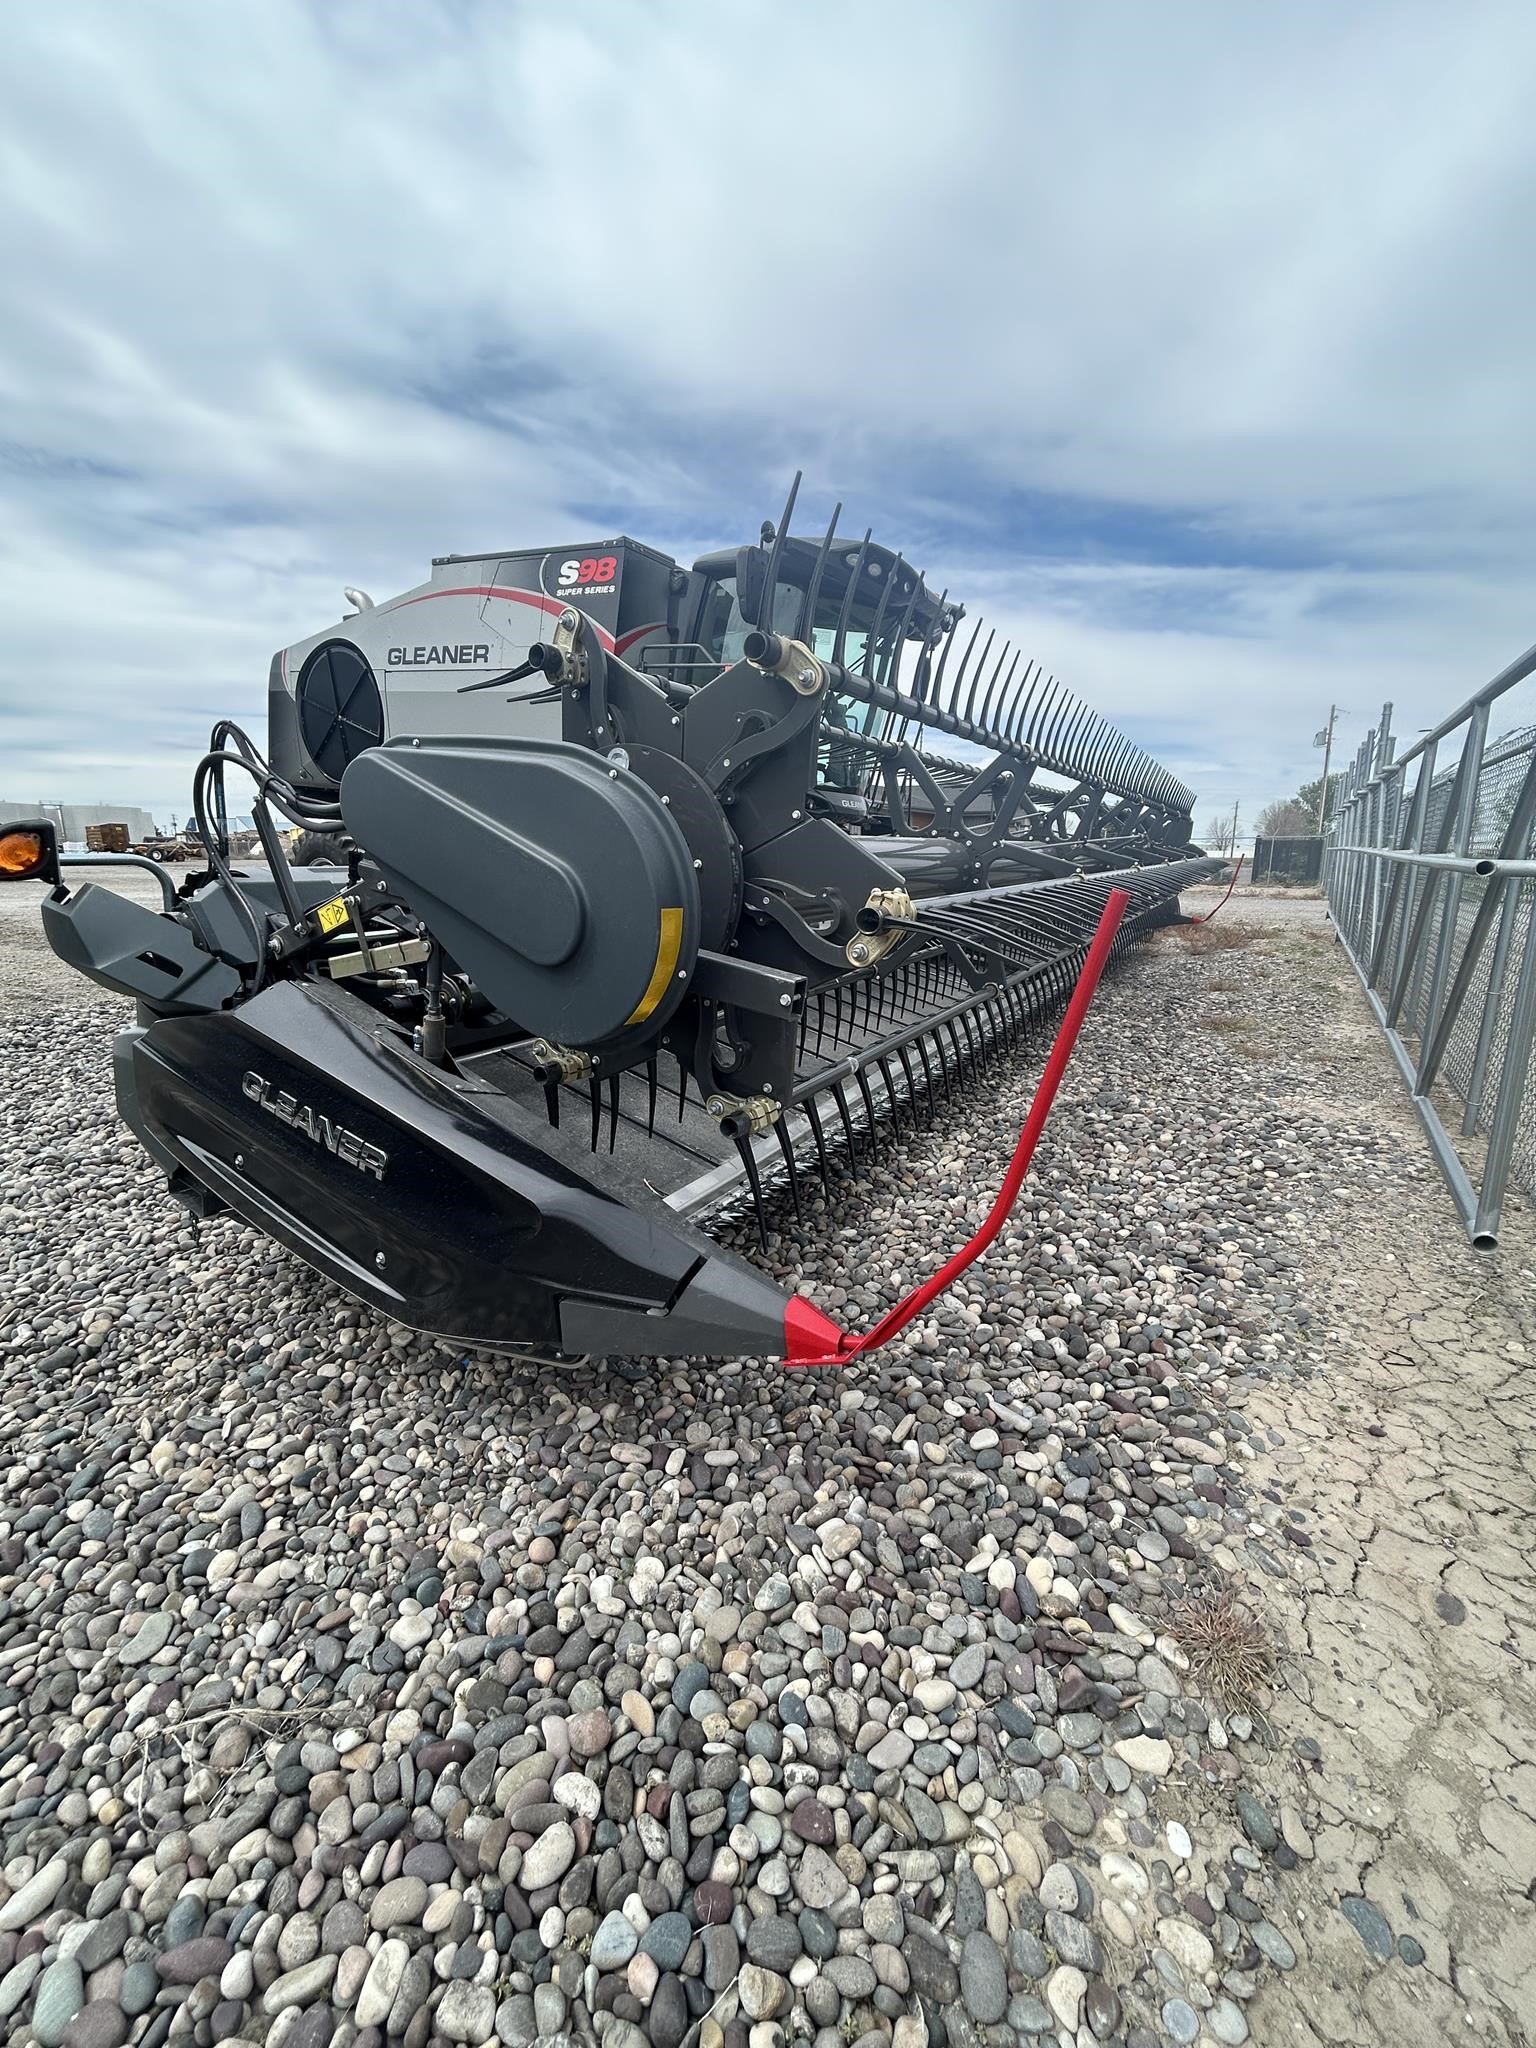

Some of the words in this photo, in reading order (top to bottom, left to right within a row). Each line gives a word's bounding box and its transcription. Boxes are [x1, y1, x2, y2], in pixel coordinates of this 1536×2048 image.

[558, 556, 618, 585] S98
[556, 587, 583, 597] SUPER
[584, 585, 616, 595] SERIES
[387, 644, 490, 666] GLEANER
[242, 1071, 388, 1181] GLEANER
